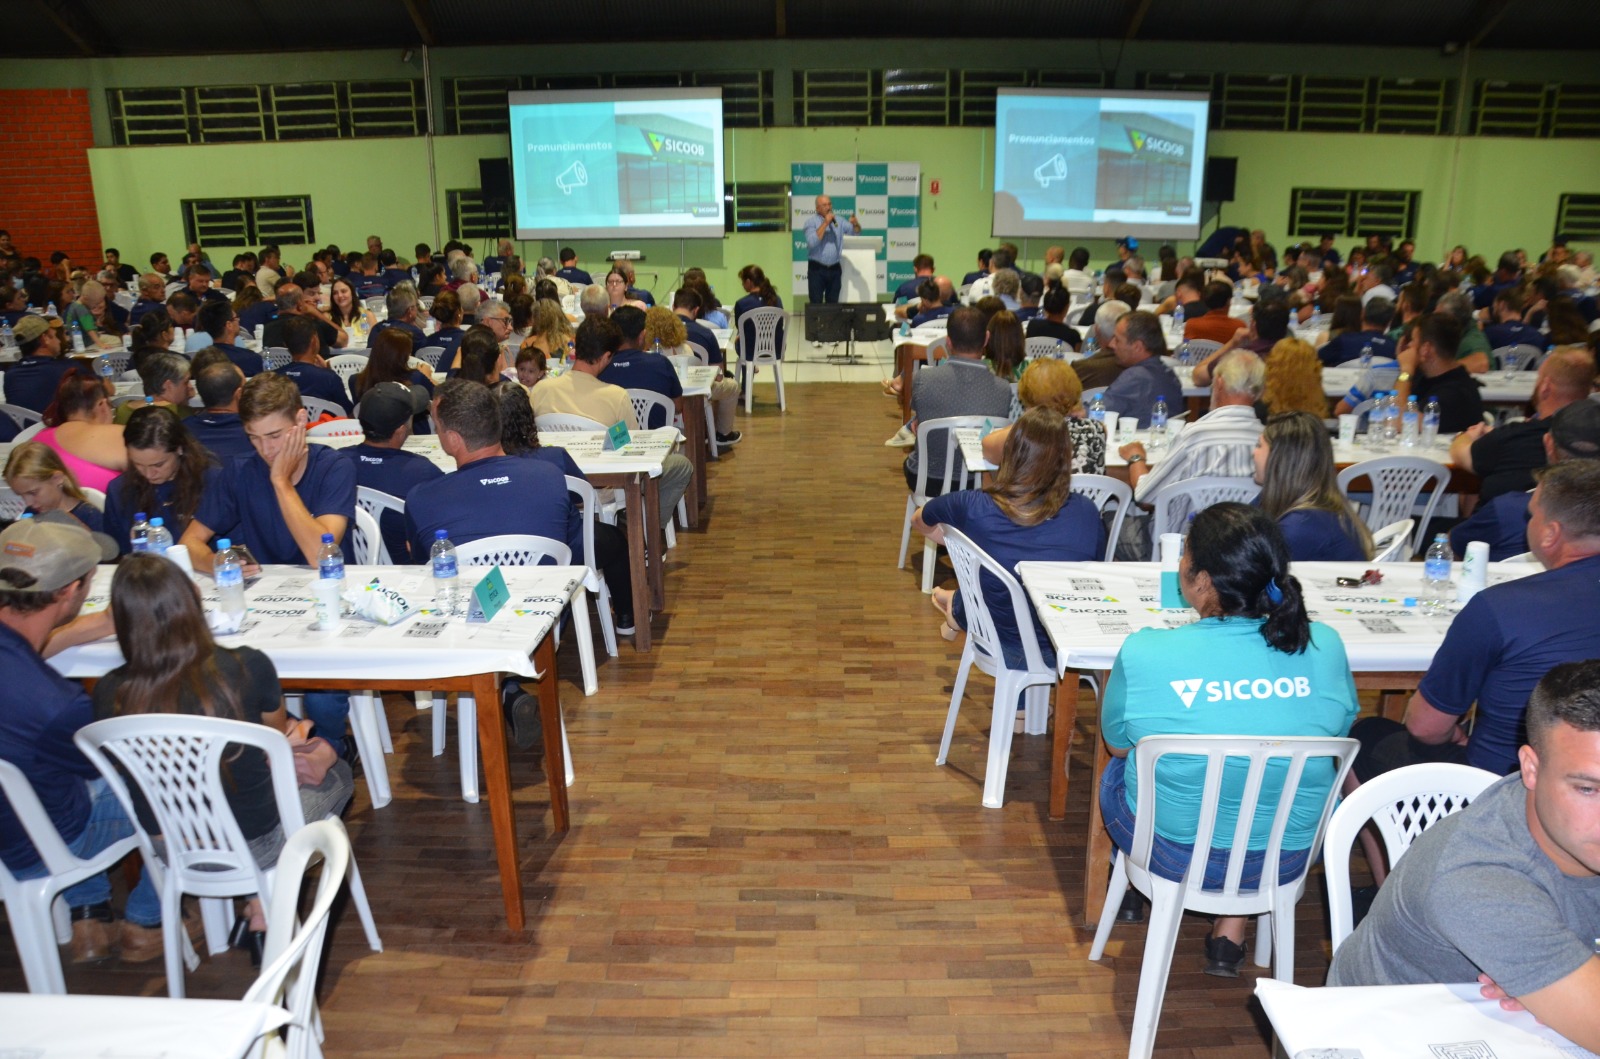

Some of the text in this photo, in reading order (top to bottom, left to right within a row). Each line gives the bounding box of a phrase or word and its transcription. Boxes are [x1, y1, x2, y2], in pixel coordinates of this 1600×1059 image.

[1008, 133, 1096, 146] Pronunciamentos
[527, 142, 613, 153] Pronunciamentos
[665, 138, 705, 157] SICOOB
[1146, 137, 1185, 157] SICOOB
[800, 175, 822, 183] SICOOB
[865, 175, 886, 183] SICOOB
[487, 476, 510, 484] SICOOB
[1044, 594, 1102, 602] SICOOB
[1206, 677, 1311, 702] SICOOB
